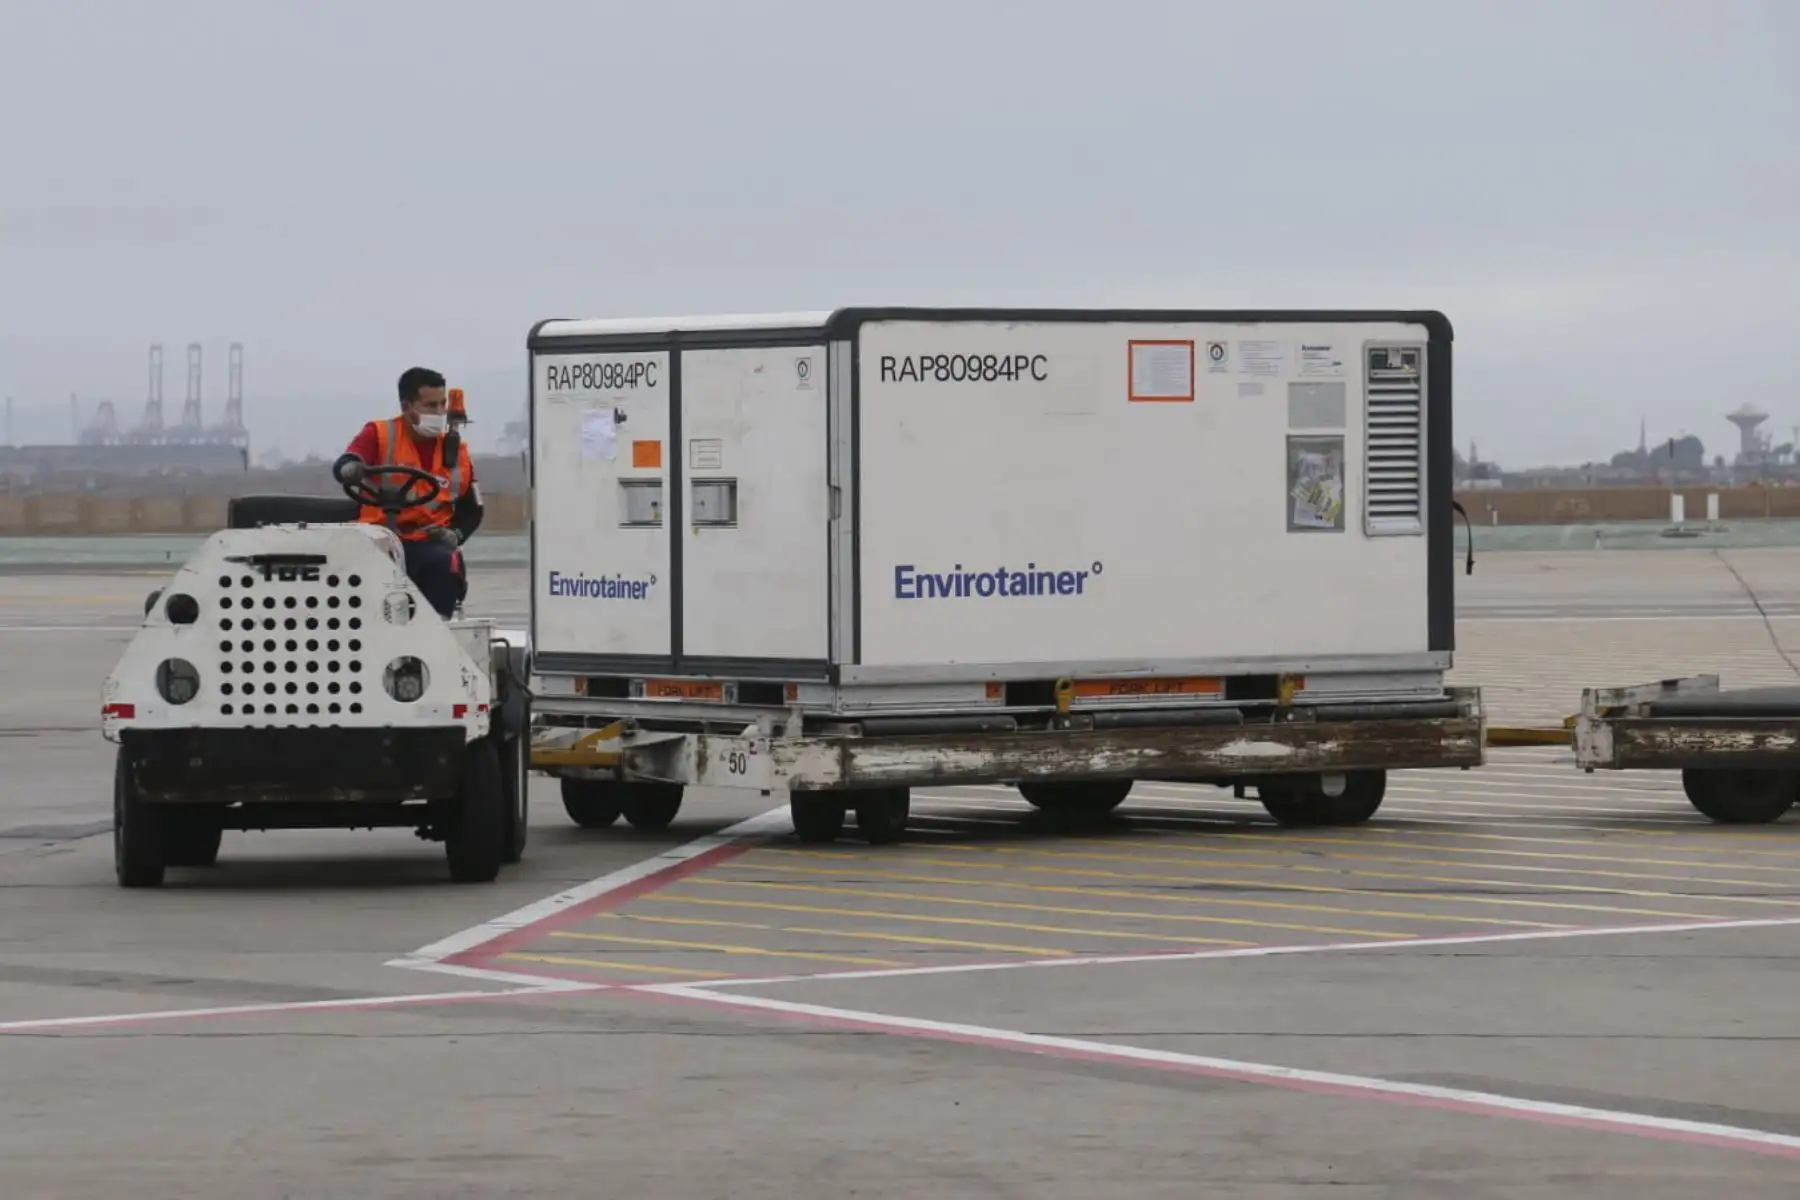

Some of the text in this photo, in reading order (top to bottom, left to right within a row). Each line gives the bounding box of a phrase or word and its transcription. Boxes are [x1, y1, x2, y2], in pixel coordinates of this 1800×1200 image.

[547, 361, 657, 391] RAP80984PC
[880, 354, 1048, 382] RAP80984PC
[729, 752, 746, 775] 50
